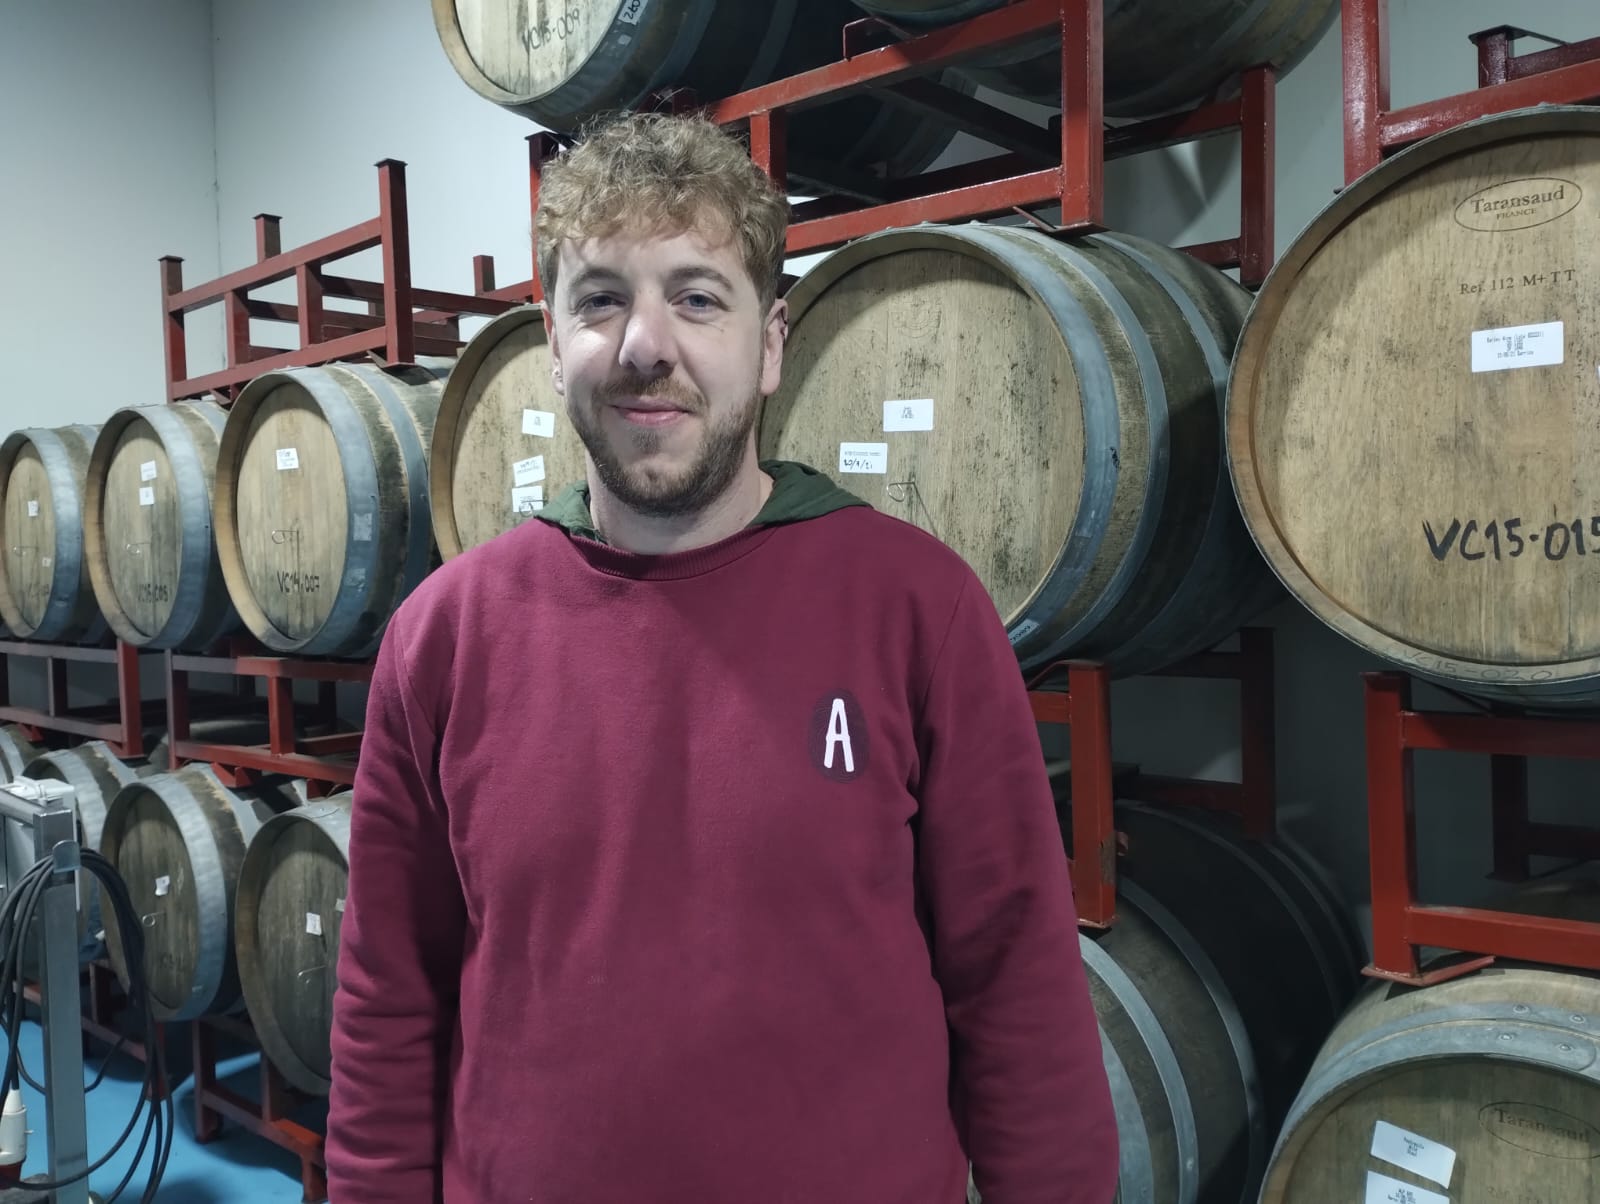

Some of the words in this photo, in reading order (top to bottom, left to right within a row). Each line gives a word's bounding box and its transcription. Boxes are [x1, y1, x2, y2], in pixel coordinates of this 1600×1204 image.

[1470, 185, 1566, 214] Taransaud
[1496, 208, 1537, 221] FRANCE
[1491, 277, 1515, 291] 112
[823, 697, 855, 773] A
